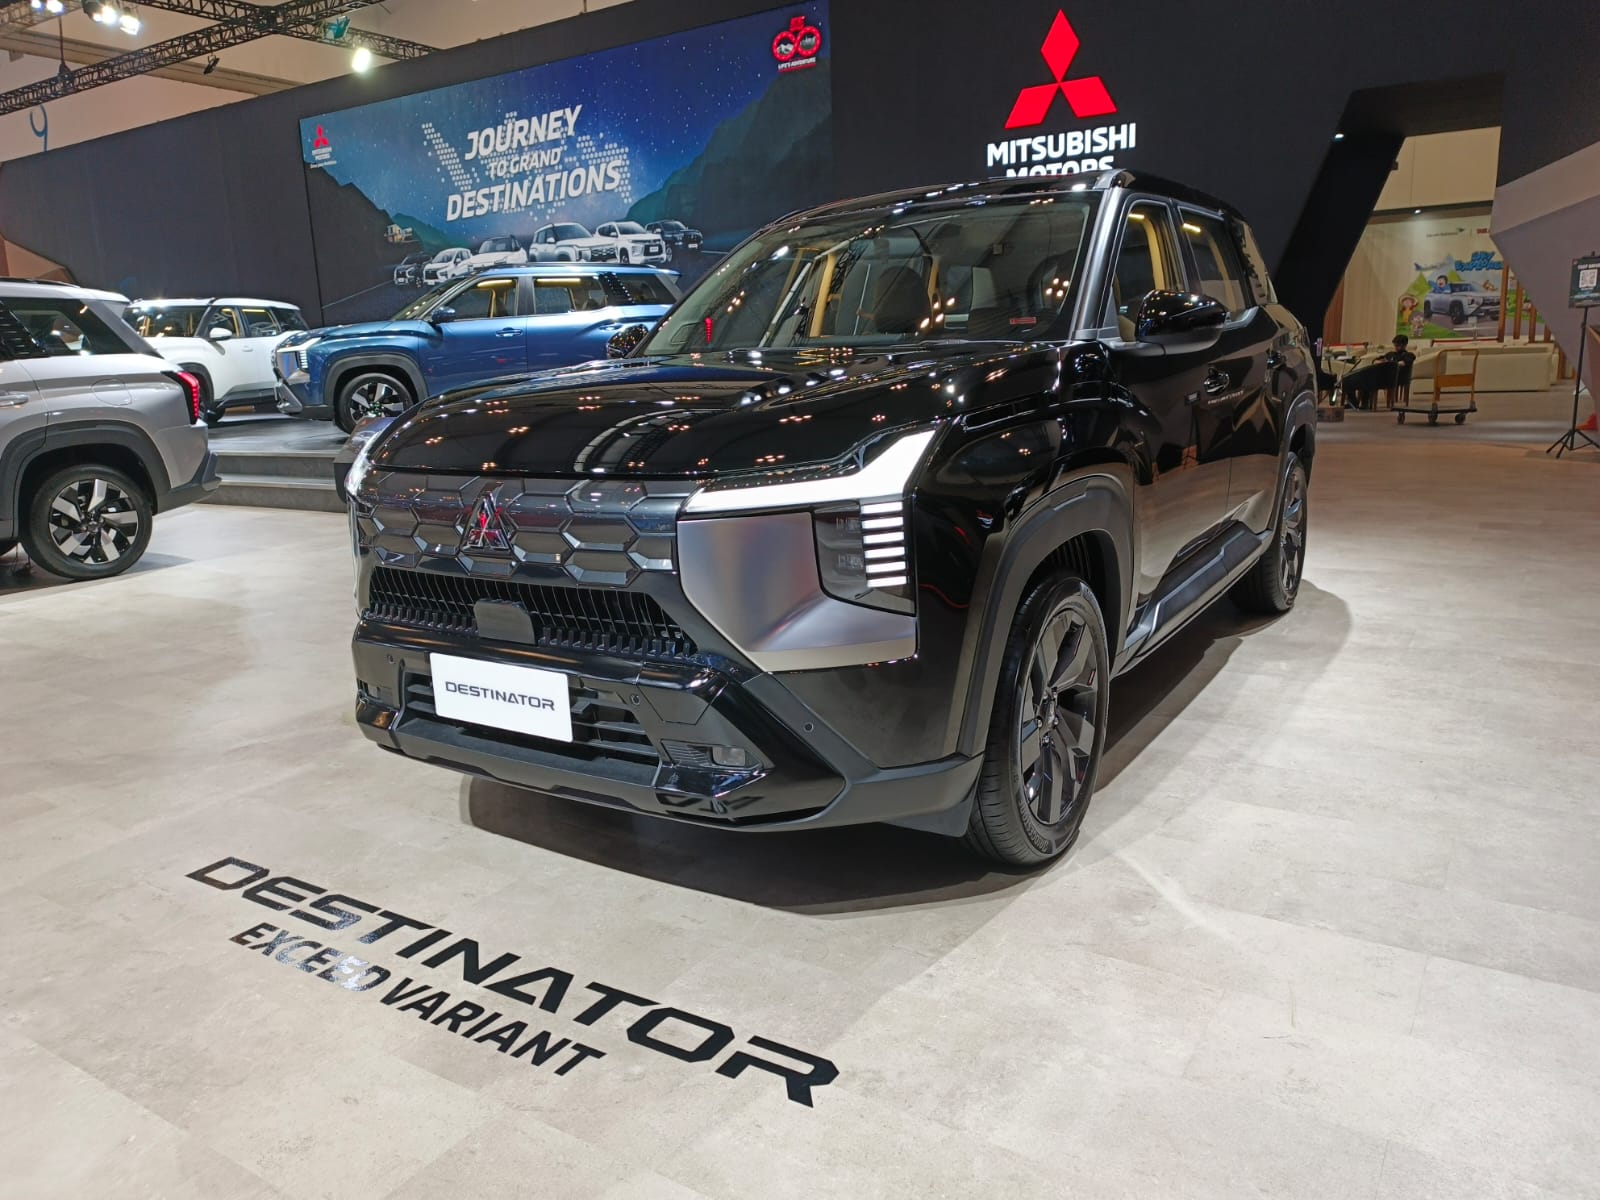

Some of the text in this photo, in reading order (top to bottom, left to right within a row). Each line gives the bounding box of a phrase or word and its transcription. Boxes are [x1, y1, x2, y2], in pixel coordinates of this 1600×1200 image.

[465, 104, 582, 160] JOURNEY
[987, 122, 1136, 167] MITSUBISHI
[446, 159, 623, 221] DESTINATIONS
[489, 148, 562, 179] TO GRAND
[445, 681, 556, 711] DESTINATOR
[184, 856, 840, 1108] DESTINATOR
[229, 922, 607, 1076] EXCEED VARIANT
